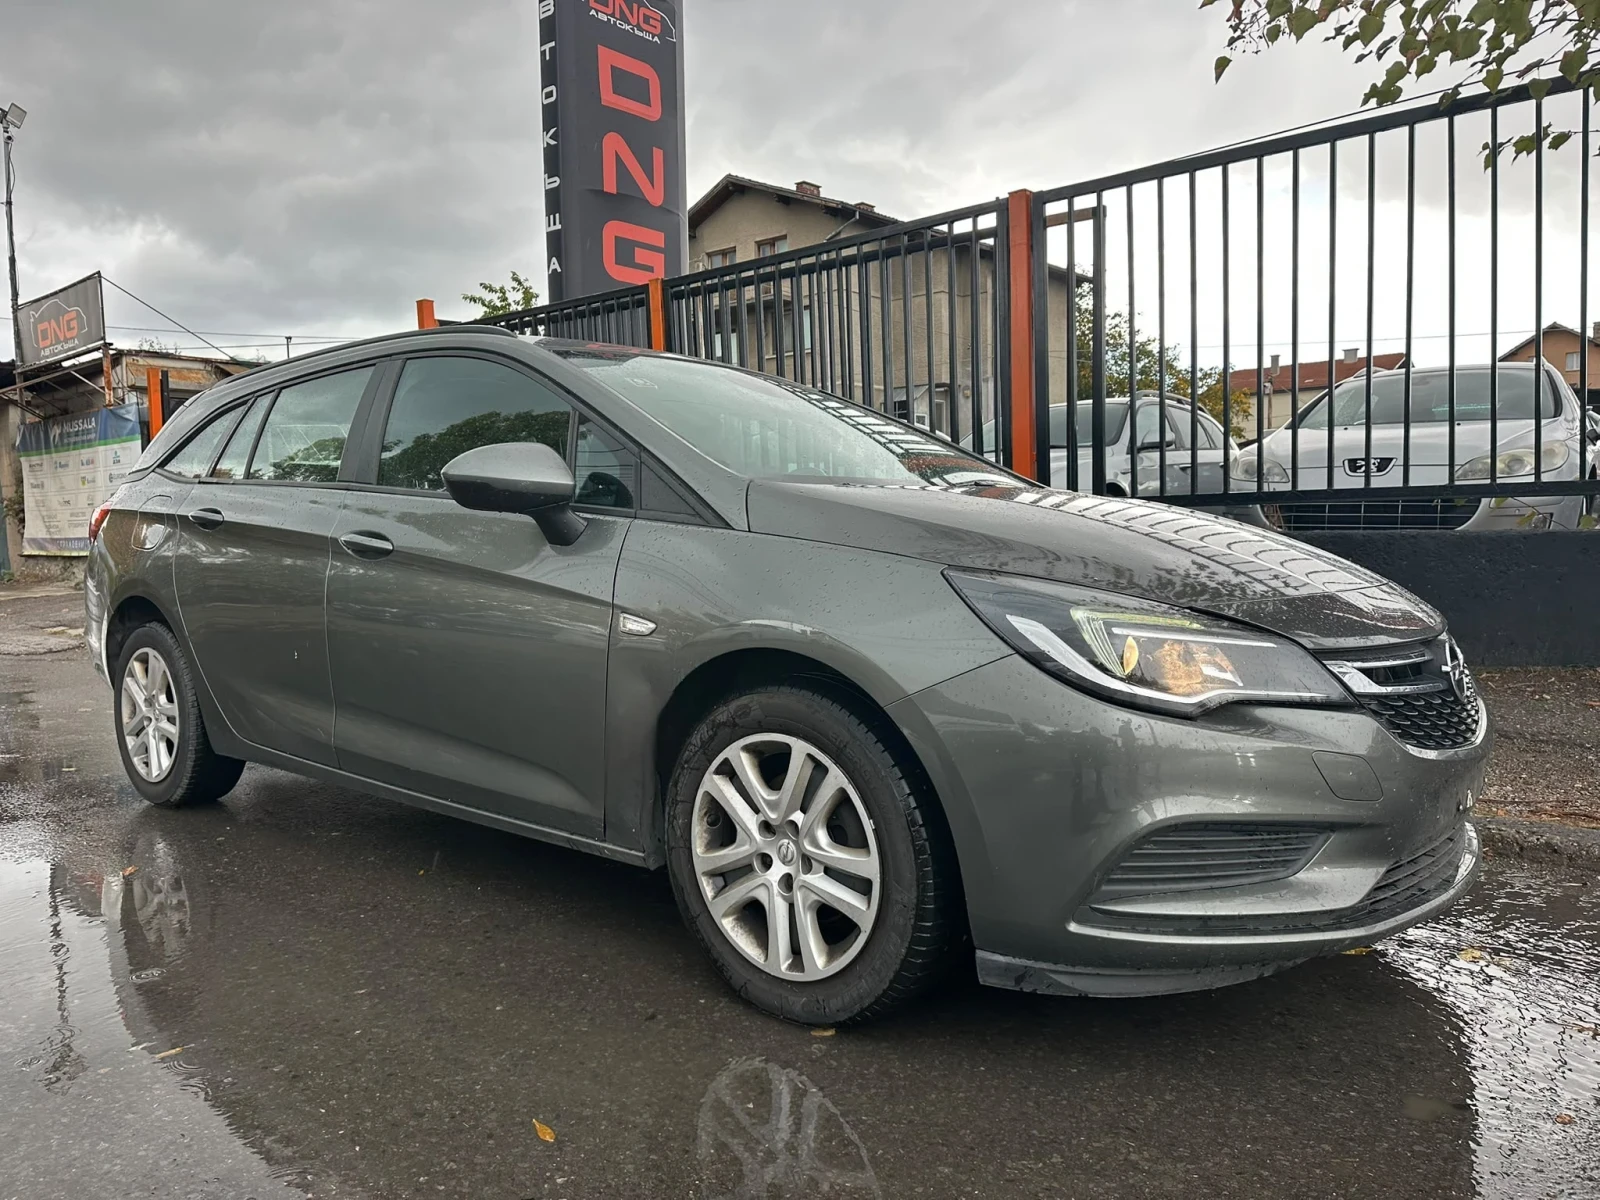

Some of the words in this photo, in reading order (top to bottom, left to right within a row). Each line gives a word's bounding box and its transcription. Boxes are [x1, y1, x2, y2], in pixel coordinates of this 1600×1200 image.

[597, 44, 665, 286] DNG
[37, 310, 78, 348] DNG
[63, 416, 96, 433] MUSSALA
